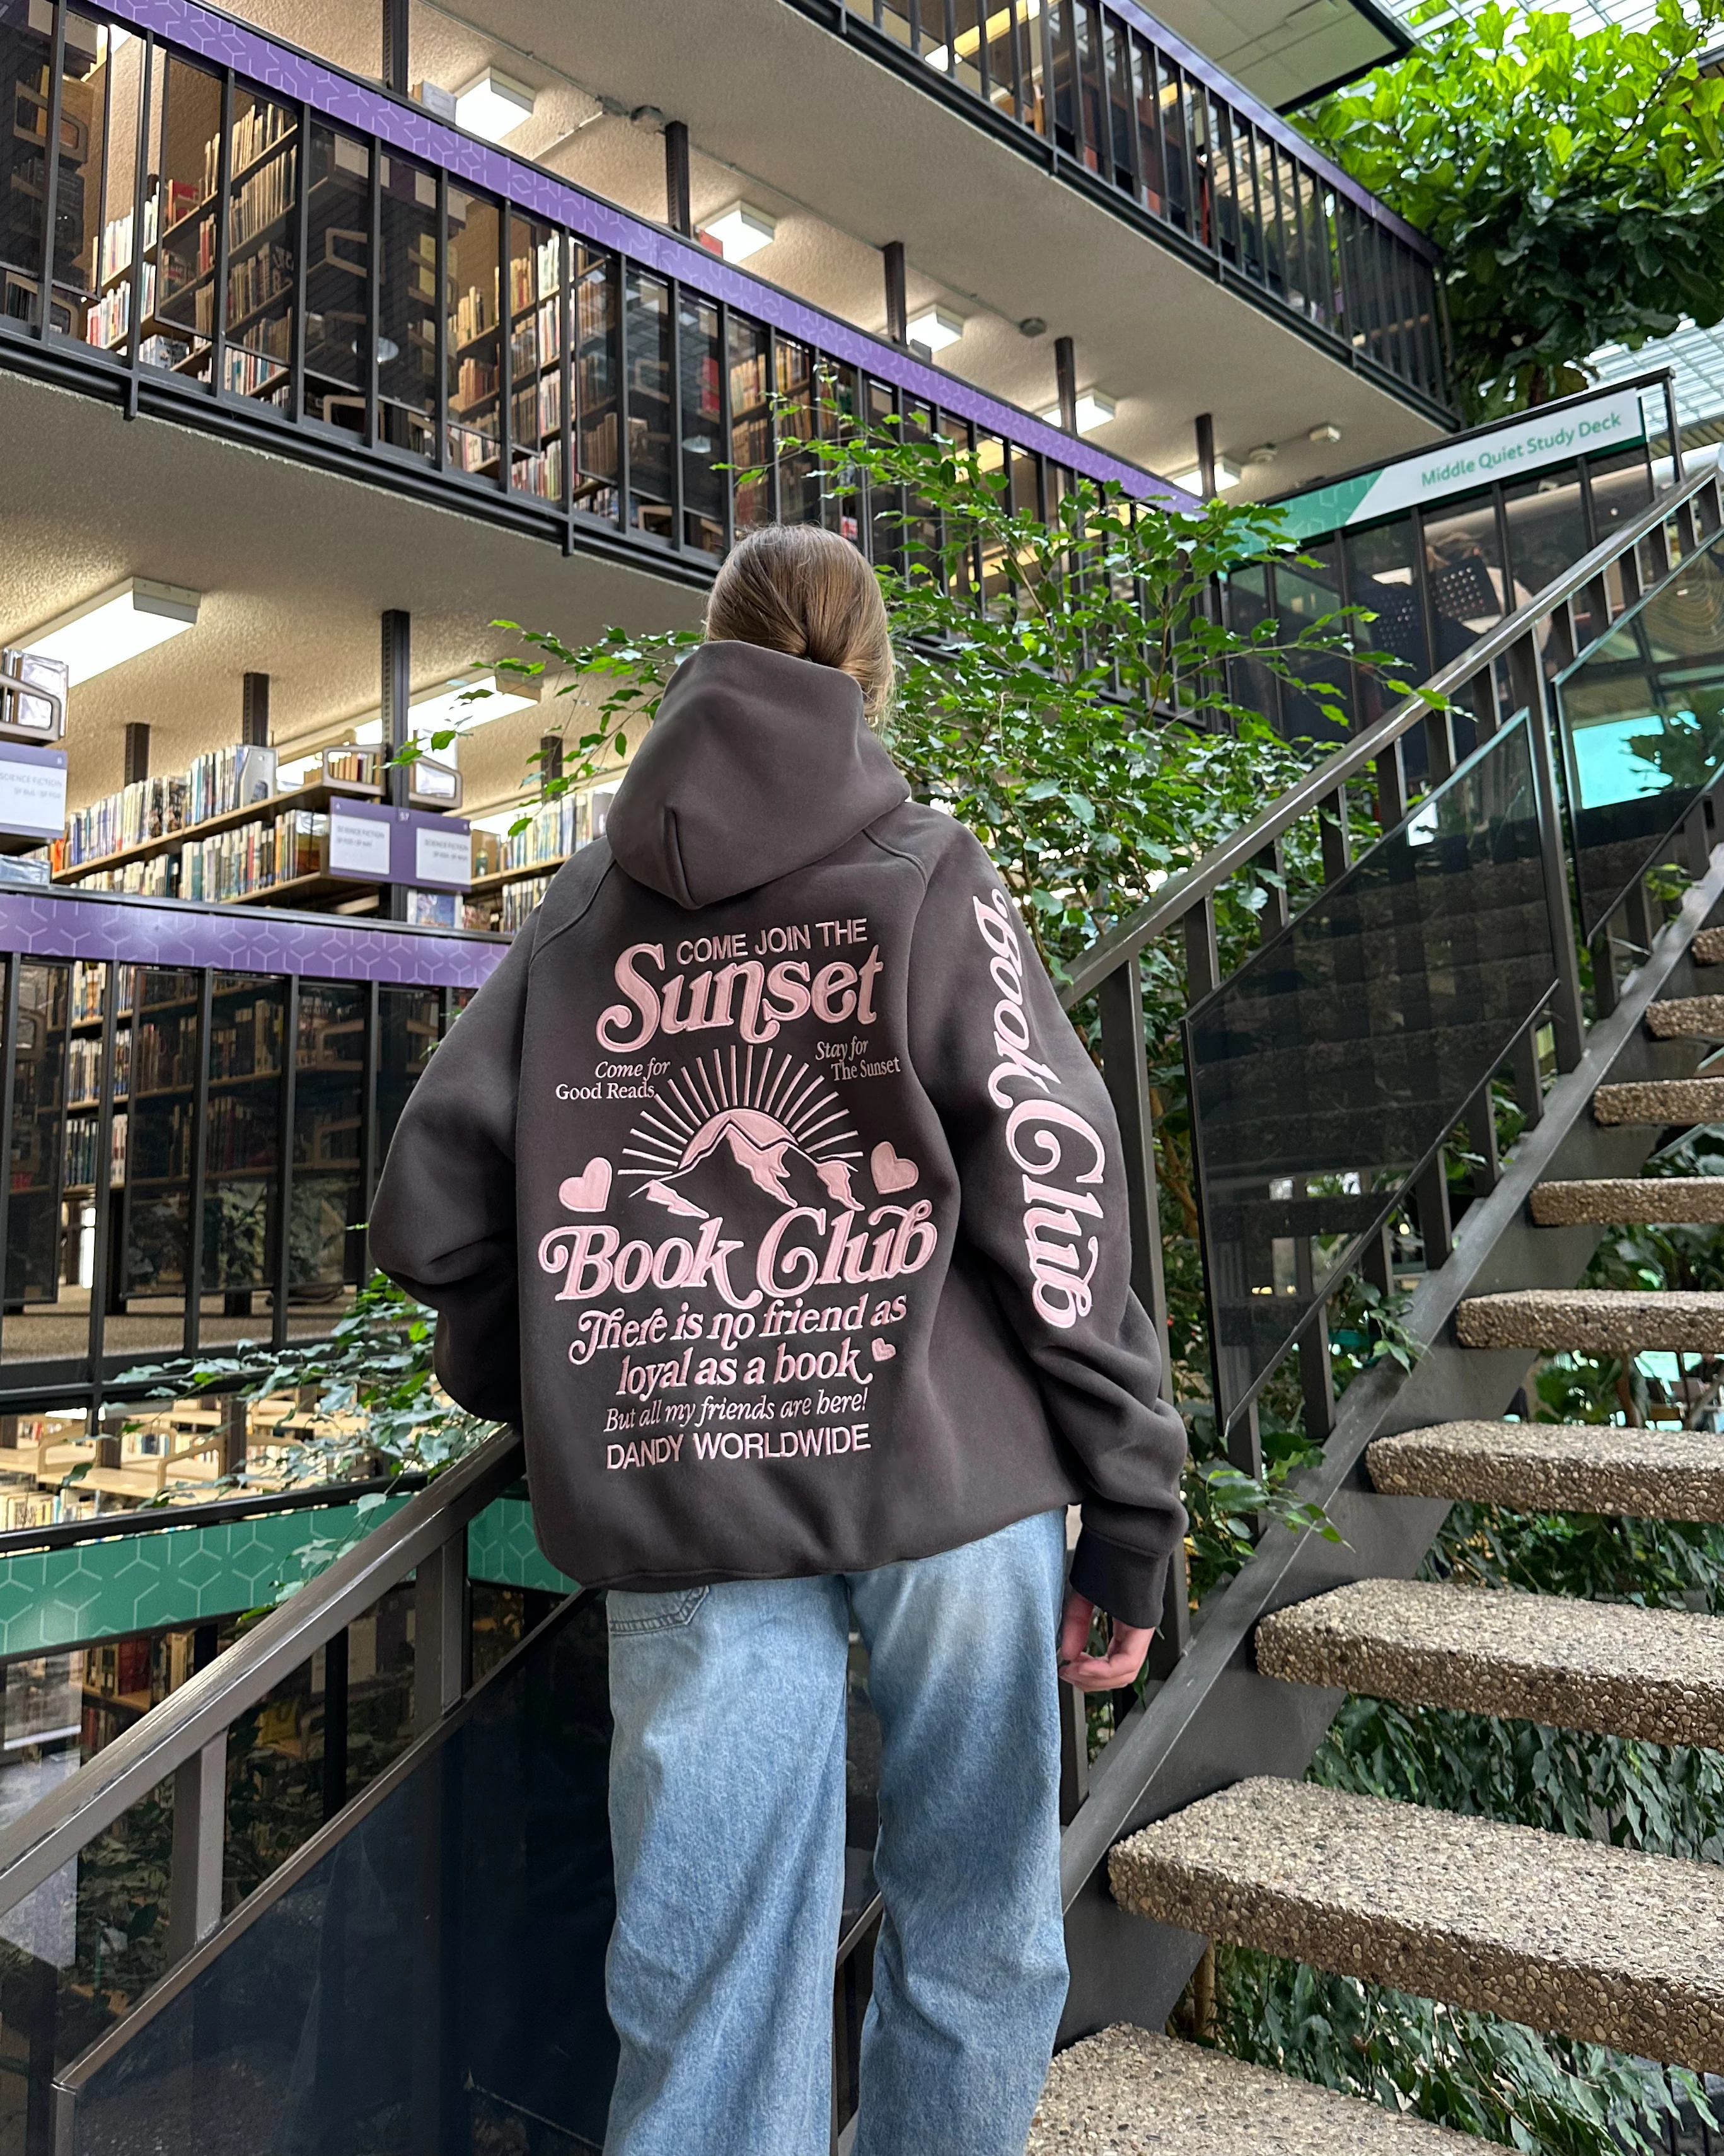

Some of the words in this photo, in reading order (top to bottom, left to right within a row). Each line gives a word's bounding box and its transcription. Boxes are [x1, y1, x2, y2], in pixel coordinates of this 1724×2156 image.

[1421, 458, 1475, 487] Middle
[1478, 443, 1524, 470] Quiet
[1527, 427, 1575, 455] Study
[1578, 410, 1621, 439] Deck
[676, 933, 748, 965] COME
[754, 924, 811, 956] JOIN
[815, 918, 868, 946] THE
[596, 943, 884, 1053] Sunset
[972, 888, 1062, 1110] Book
[594, 1061, 644, 1079] Come
[643, 1057, 671, 1081] for
[815, 1041, 848, 1062] Stay
[848, 1035, 869, 1061] for
[831, 1061, 857, 1081] The
[860, 1057, 901, 1078] Sunset
[555, 1082, 603, 1100] Good
[606, 1081, 655, 1099] Reads
[1005, 1098, 1105, 1330] Club
[538, 1216, 763, 1310] Book
[756, 1198, 939, 1299] Club
[568, 1307, 668, 1365] There
[669, 1301, 704, 1340] is
[706, 1311, 756, 1352] no
[758, 1292, 869, 1338] friend
[869, 1294, 908, 1327] as
[615, 1347, 694, 1402] loyal
[693, 1355, 738, 1386] as
[743, 1356, 766, 1386] a
[773, 1336, 874, 1385] book
[603, 1408, 635, 1432] But
[639, 1400, 661, 1426] all
[664, 1403, 696, 1428] my
[694, 1394, 775, 1427] friends
[780, 1397, 812, 1418] are
[816, 1387, 869, 1415] here!
[606, 1433, 685, 1469] DANDY
[692, 1422, 872, 1460] WORLDWIDE
